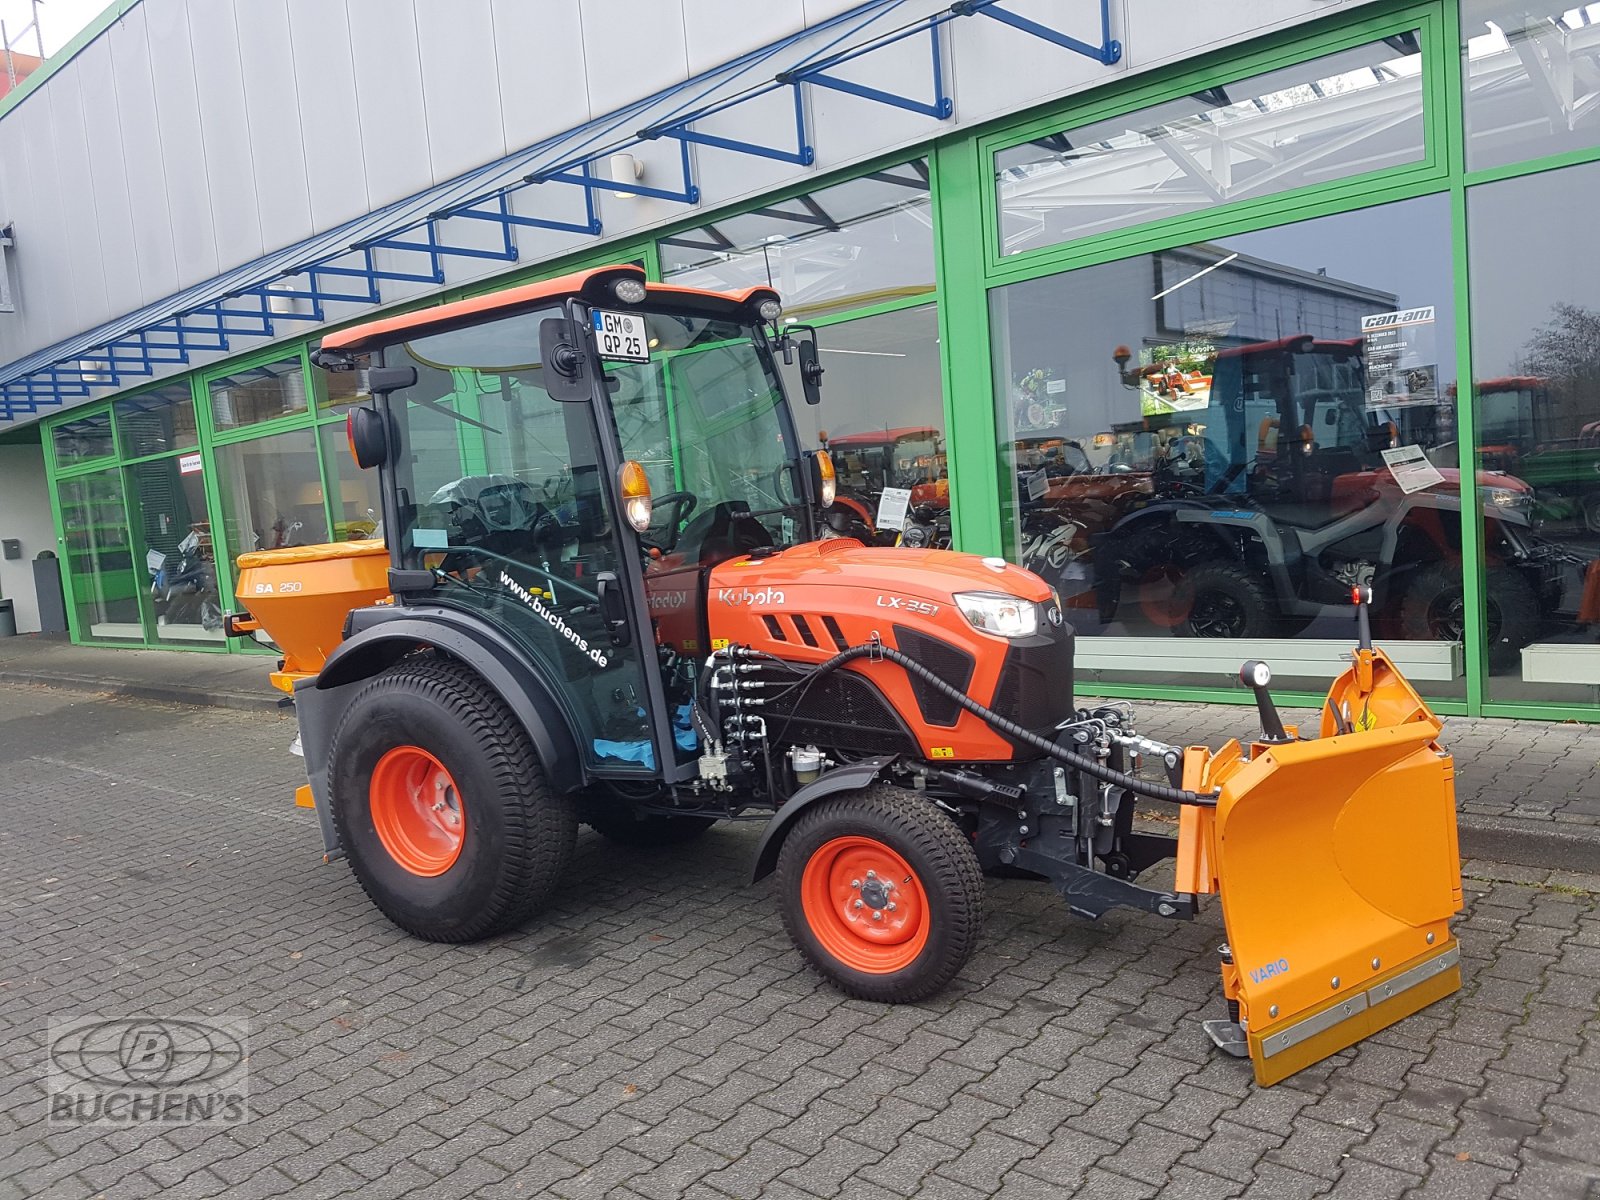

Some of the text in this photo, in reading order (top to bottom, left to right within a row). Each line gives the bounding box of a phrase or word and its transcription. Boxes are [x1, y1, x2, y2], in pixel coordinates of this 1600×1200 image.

[604, 314, 623, 334] GM
[1365, 309, 1432, 327] can-am
[604, 334, 641, 355] QP 25
[255, 581, 303, 594] SA 250
[718, 586, 786, 607] Kubota
[876, 595, 940, 617] LX-351
[500, 570, 608, 668] www.buchens.de
[1249, 958, 1289, 983] VARIO
